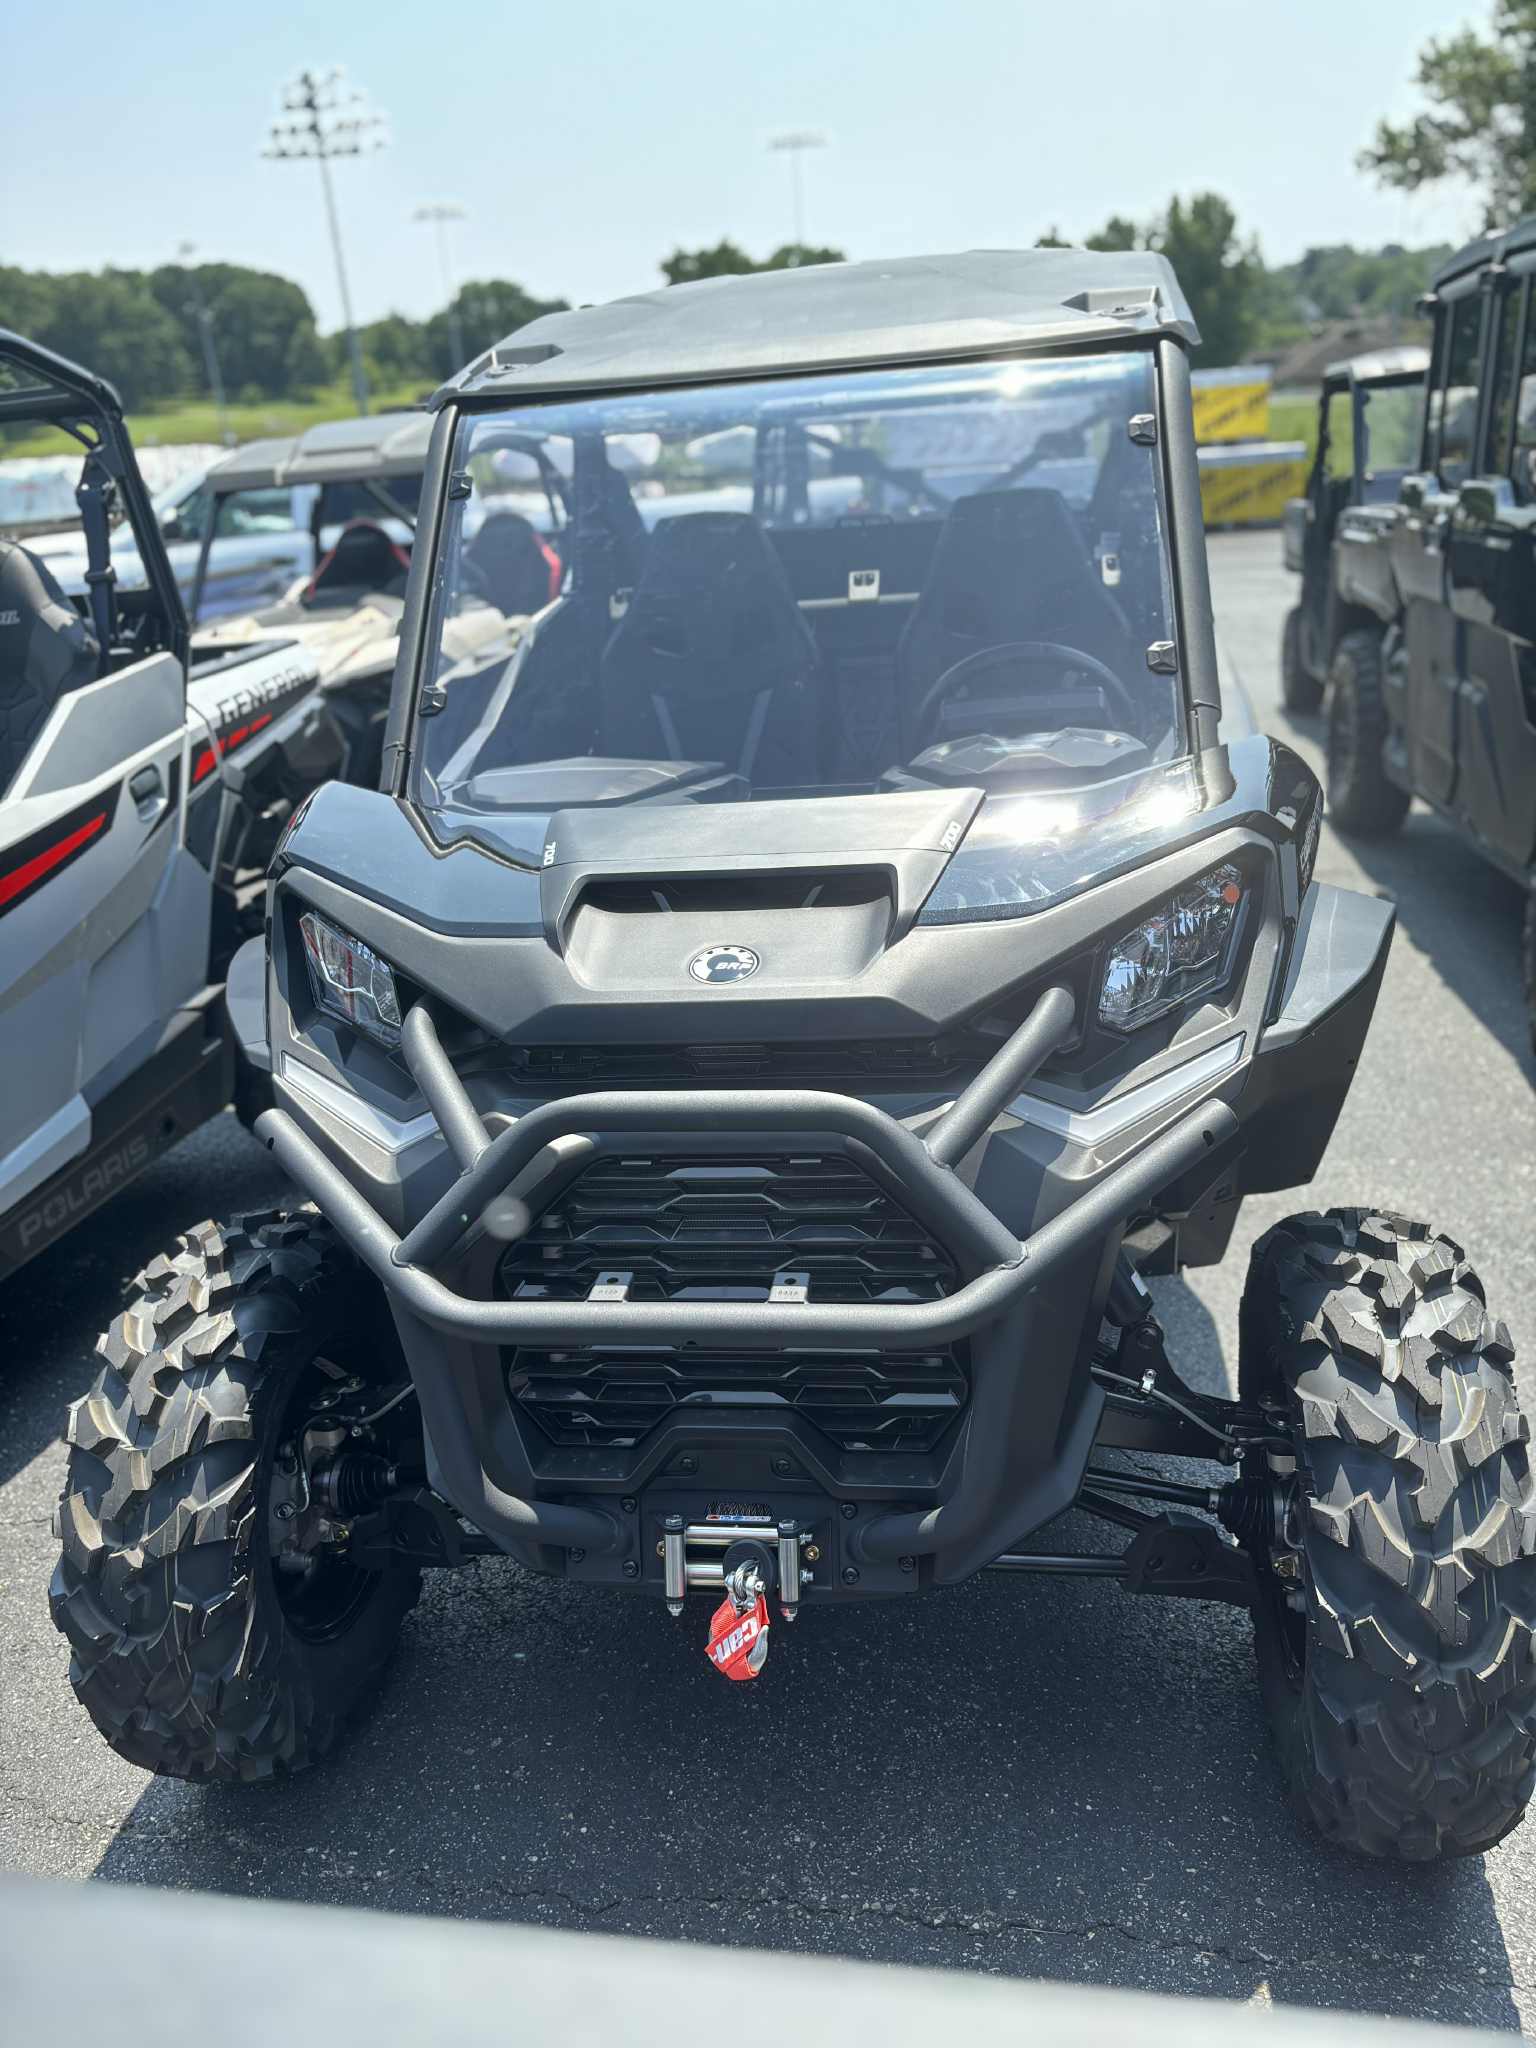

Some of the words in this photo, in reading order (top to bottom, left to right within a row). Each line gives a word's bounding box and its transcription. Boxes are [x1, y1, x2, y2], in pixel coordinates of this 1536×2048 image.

[216, 664, 315, 728] GENERAL
[940, 820, 961, 851] 700
[544, 841, 556, 866] 700
[714, 961, 754, 970] BRP
[18, 1135, 149, 1248] POLARIS
